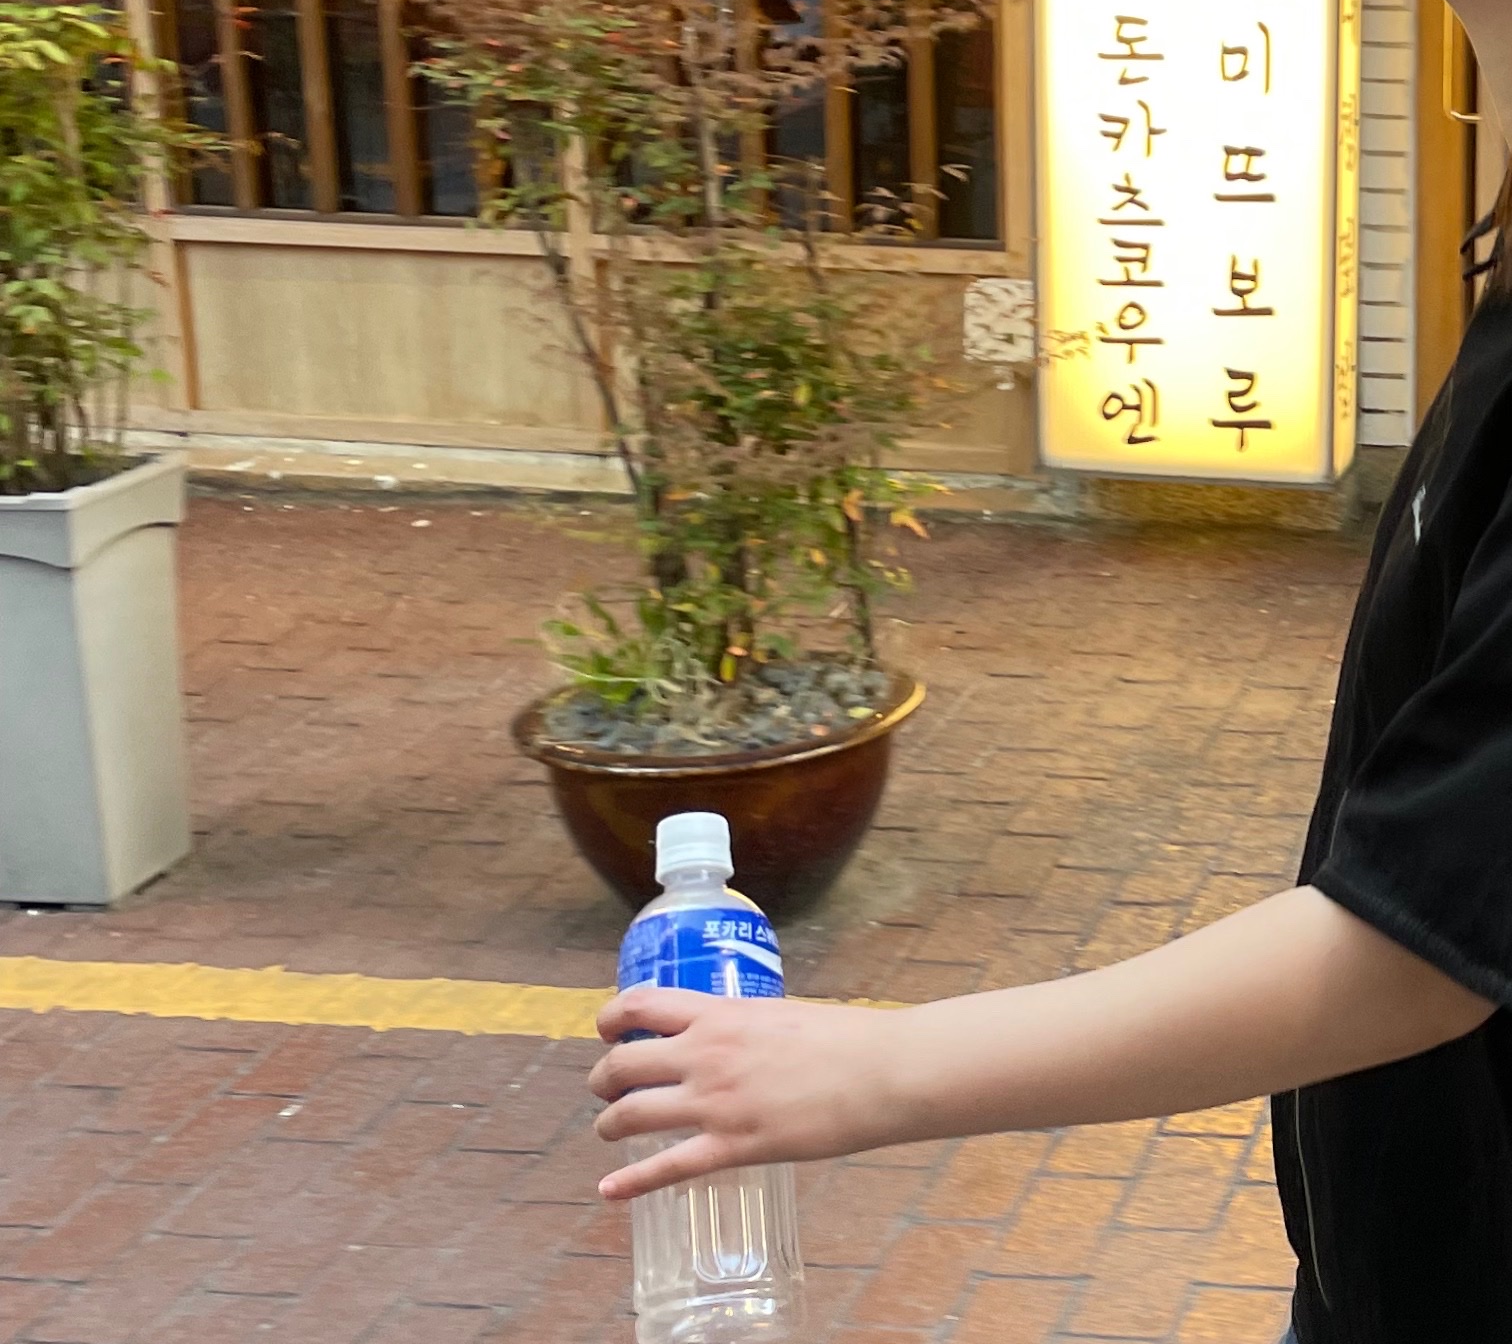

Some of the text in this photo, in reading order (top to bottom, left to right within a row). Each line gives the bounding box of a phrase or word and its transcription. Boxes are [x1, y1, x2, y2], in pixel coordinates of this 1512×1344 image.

[1097, 14, 1167, 446] 돈카츠코우엔
[1208, 20, 1276, 453] 미뜨보루
[702, 920, 752, 941] 포카리
